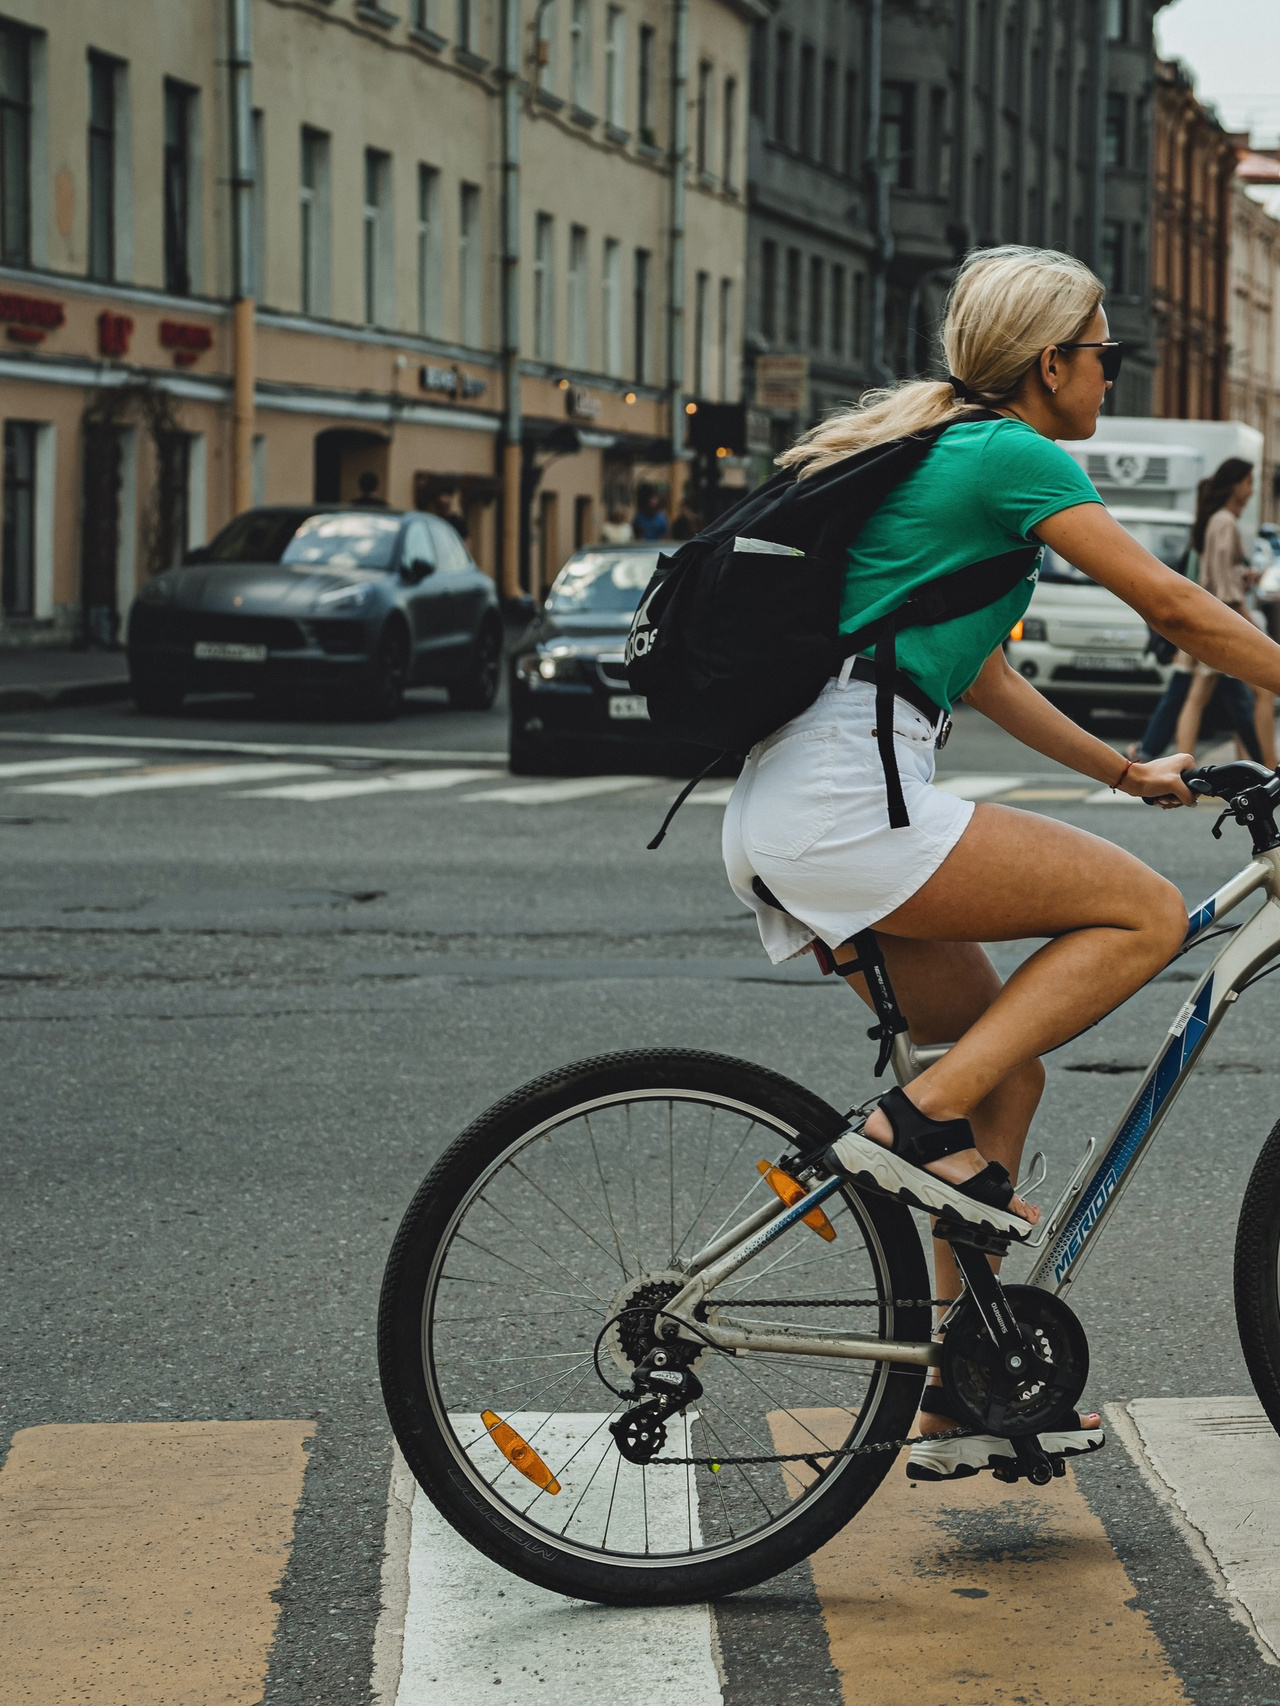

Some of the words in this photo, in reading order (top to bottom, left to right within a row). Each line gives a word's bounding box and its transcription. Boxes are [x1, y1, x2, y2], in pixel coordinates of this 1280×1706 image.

[1054, 1168, 1118, 1284] MERIDA
[991, 1302, 1008, 1334] SHIMANO
[447, 1468, 561, 1561] MERIDA
